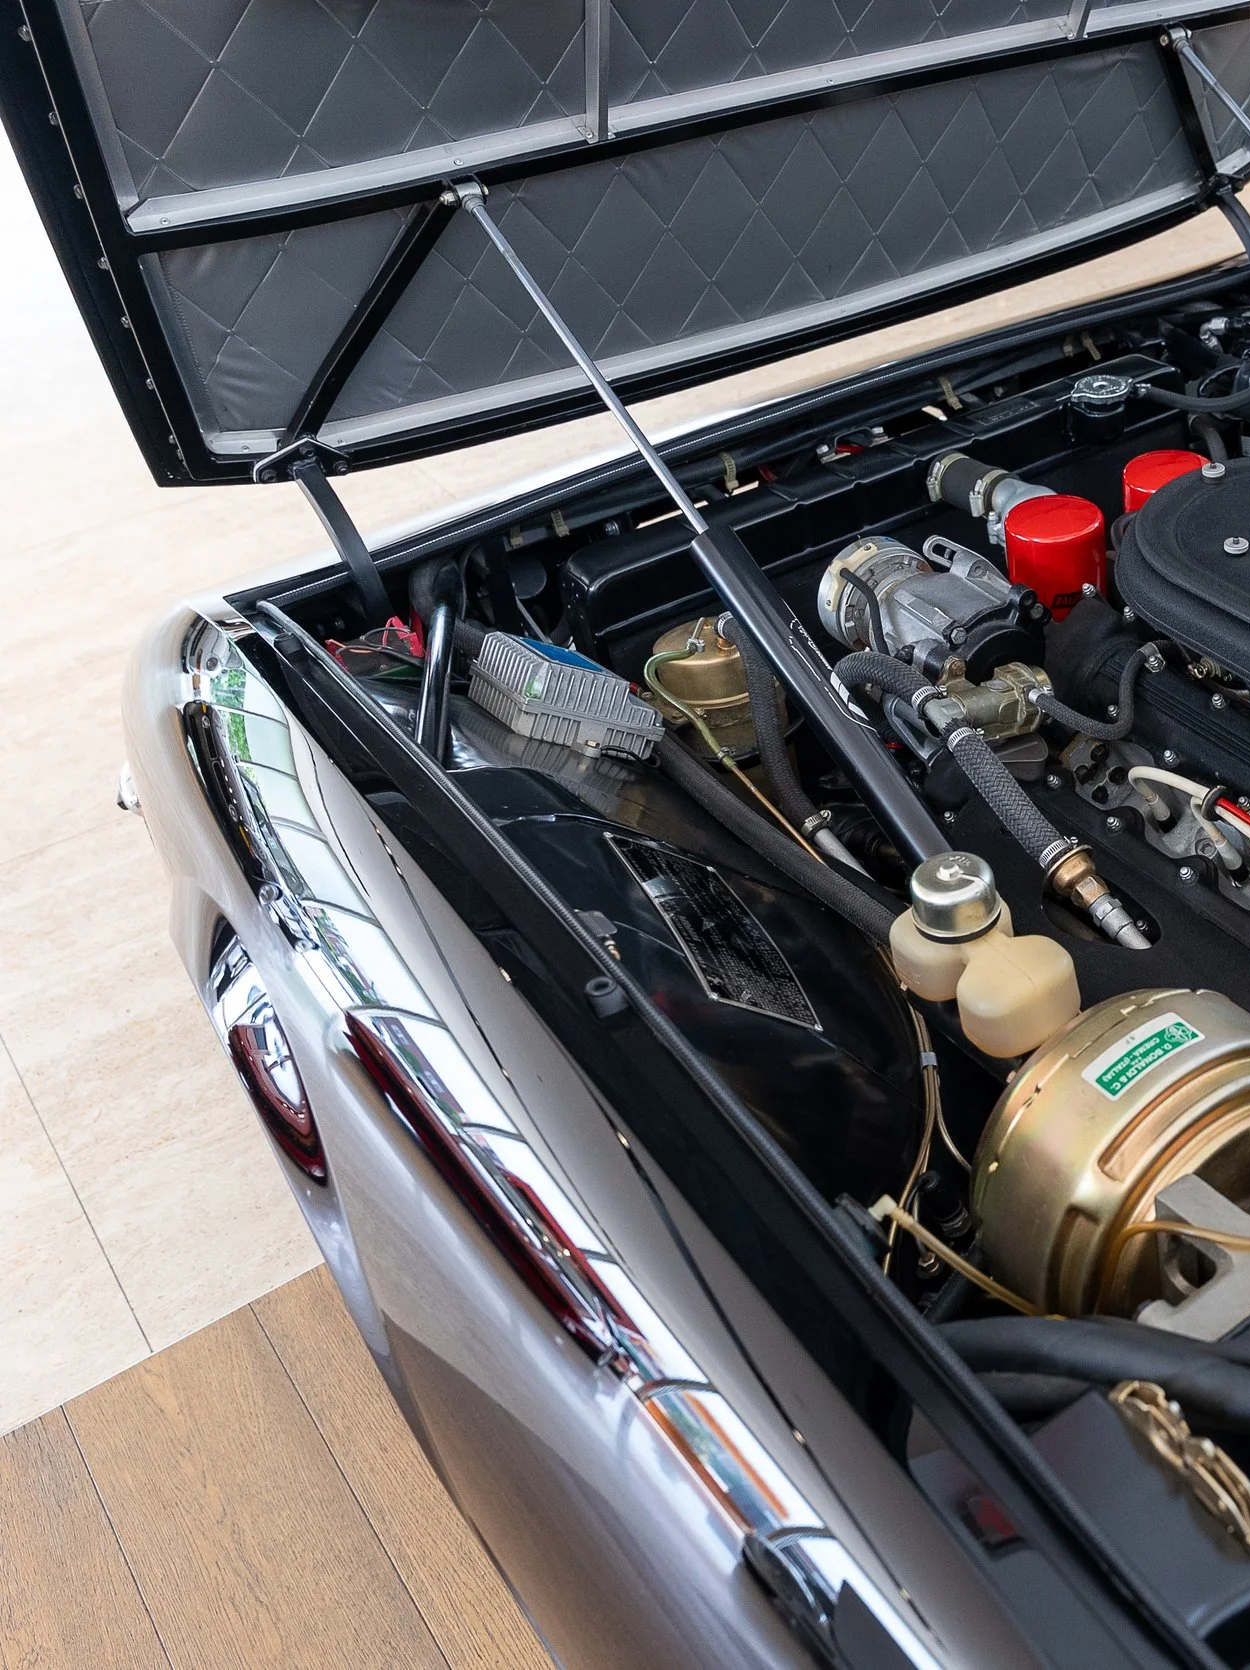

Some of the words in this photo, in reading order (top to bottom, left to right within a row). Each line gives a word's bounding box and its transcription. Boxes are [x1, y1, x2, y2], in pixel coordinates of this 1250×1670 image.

[1132, 1037, 1160, 1057] CREMA
[1102, 1057, 1130, 1082] (ITALIA)
[1126, 1048, 1164, 1078] BONALDI
